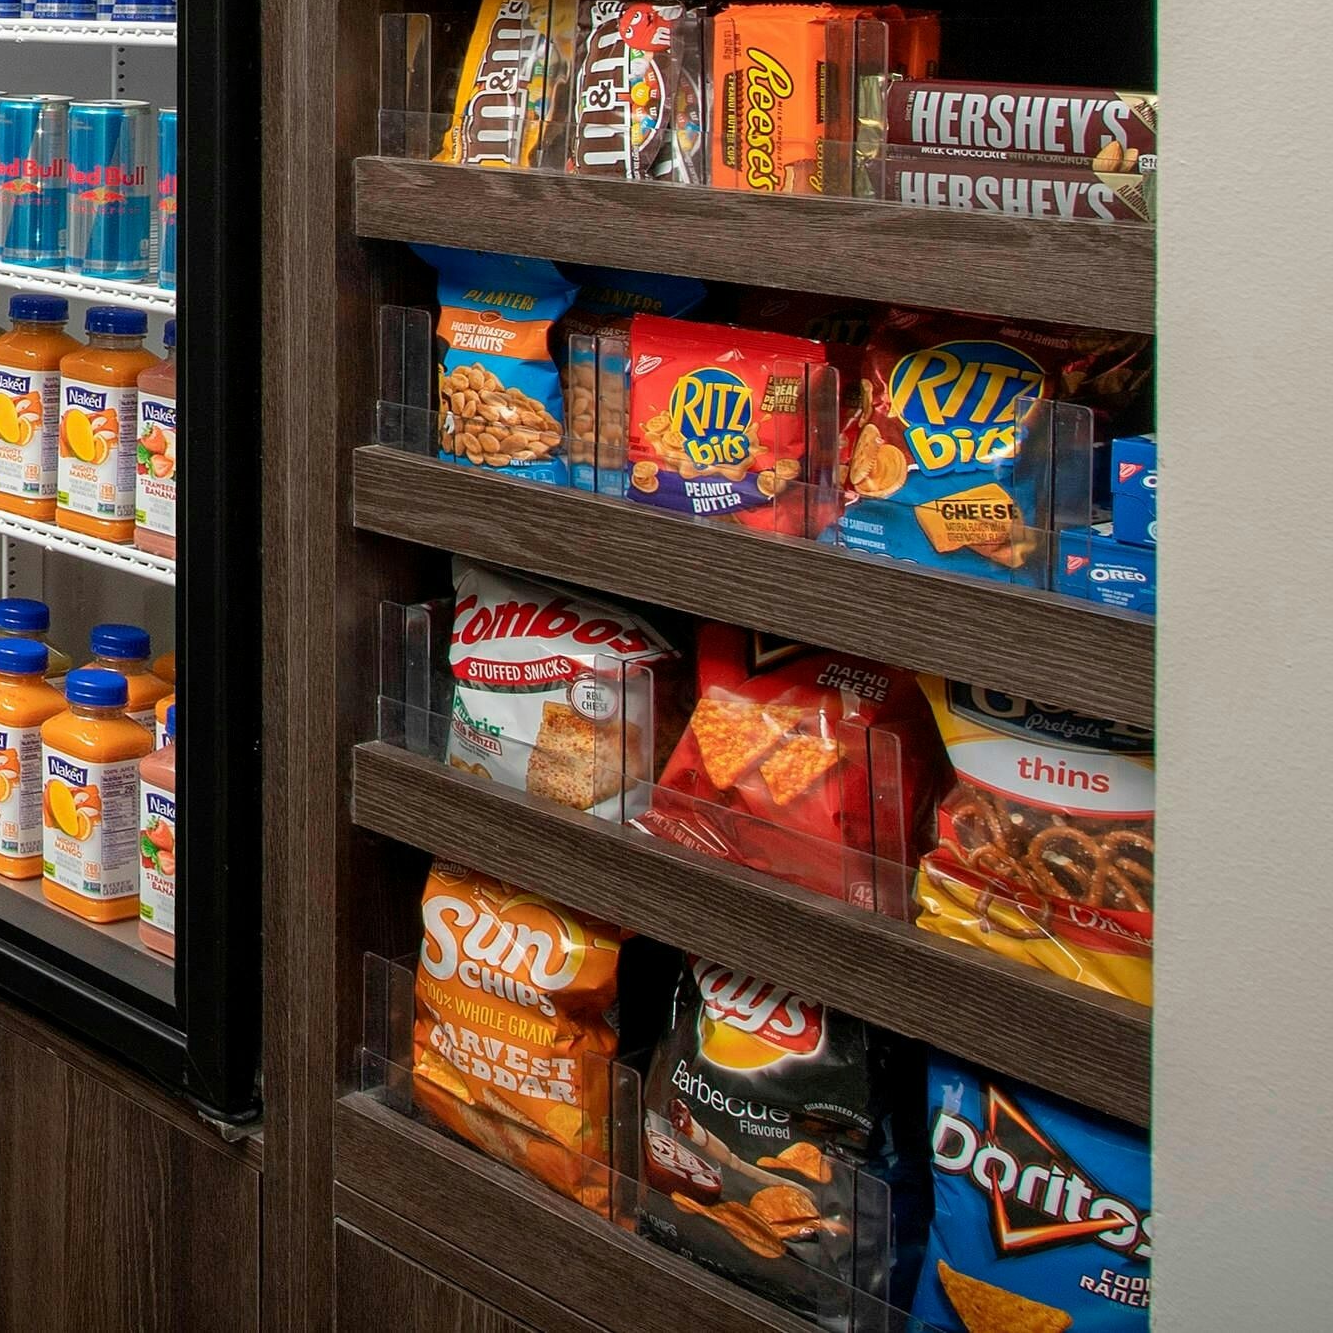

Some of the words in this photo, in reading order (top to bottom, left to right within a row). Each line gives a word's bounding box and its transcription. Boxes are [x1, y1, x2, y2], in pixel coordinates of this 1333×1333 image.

[746, 47, 794, 192] Reese's
[911, 91, 1131, 155] HERSHEY'S
[463, 288, 538, 312] PLANTERS
[451, 322, 476, 335] HONEY
[476, 324, 517, 341] ROASTED
[453, 334, 504, 353] PEANUTS
[69, 389, 102, 408] Naked
[888, 350, 1045, 425] RITZ
[670, 374, 753, 438] RITZ
[686, 431, 751, 465] bits
[685, 481, 733, 499] PEANUT
[692, 494, 742, 514] BUTTER
[941, 503, 1017, 520] CHEESE
[1090, 568, 1146, 583] OREO
[468, 661, 522, 681] STUFFED
[524, 658, 572, 680] SNACKS
[825, 662, 890, 690] NACHO
[816, 672, 887, 702] CHEESE
[1025, 713, 1102, 739] Pretzels
[1017, 756, 1110, 794] thins
[459, 959, 557, 1017] CHIPS
[455, 996, 505, 1032] WHOLE
[508, 1017, 557, 1048] GRAIN
[671, 1059, 790, 1123] Barbecue
[740, 1120, 791, 1140] Flavored
